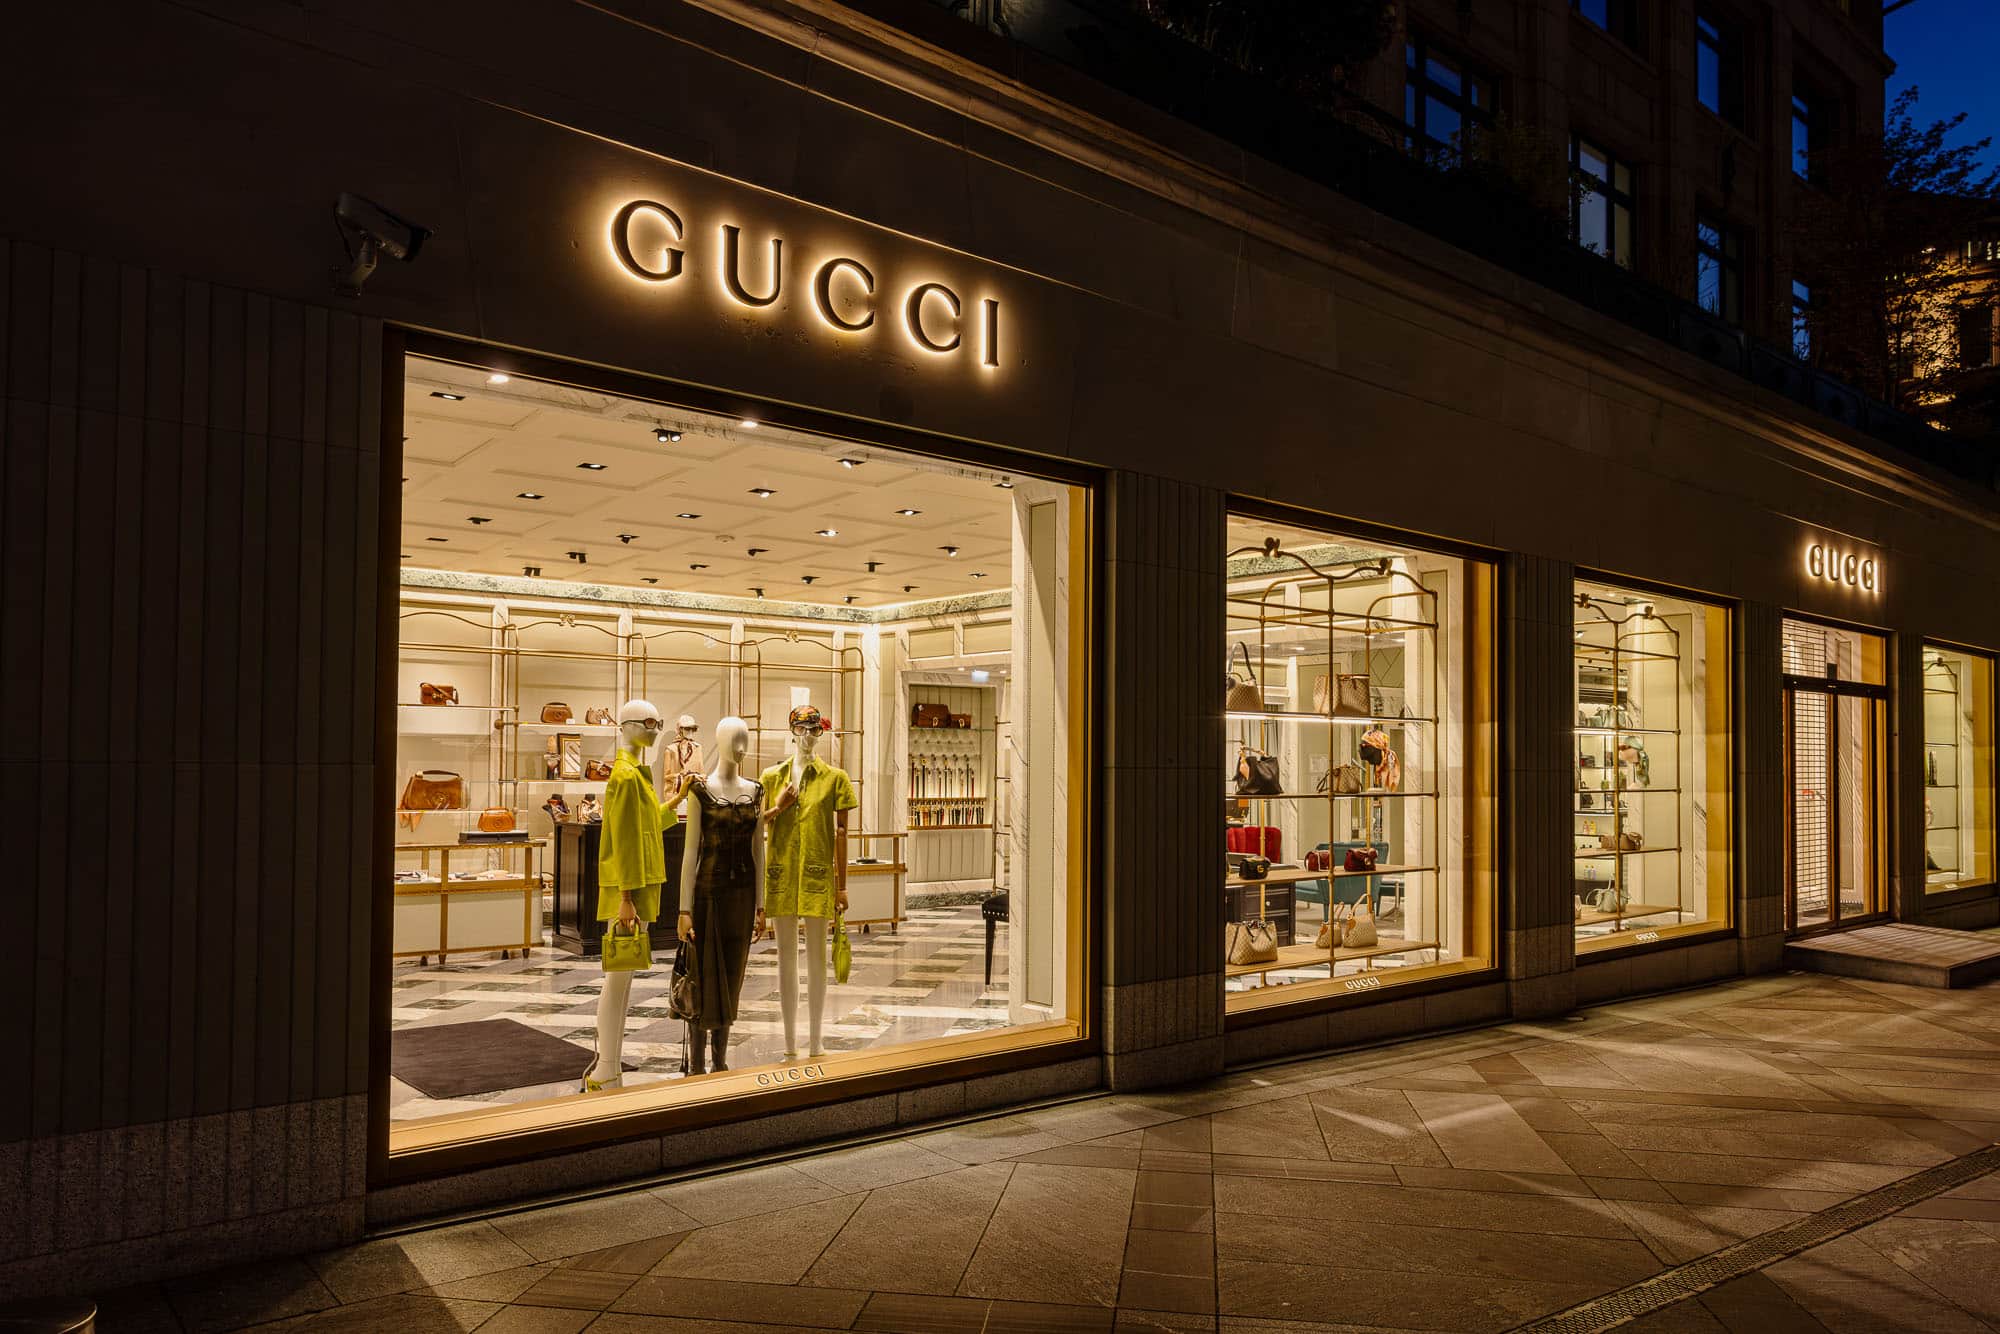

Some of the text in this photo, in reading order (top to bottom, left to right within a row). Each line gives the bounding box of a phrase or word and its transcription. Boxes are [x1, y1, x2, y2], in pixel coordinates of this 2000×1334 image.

[611, 199, 1000, 367] GUCCI
[1806, 543, 1883, 593] GUCCI
[1345, 976, 1380, 990] GUCCI
[756, 1064, 825, 1087] GUCCI
